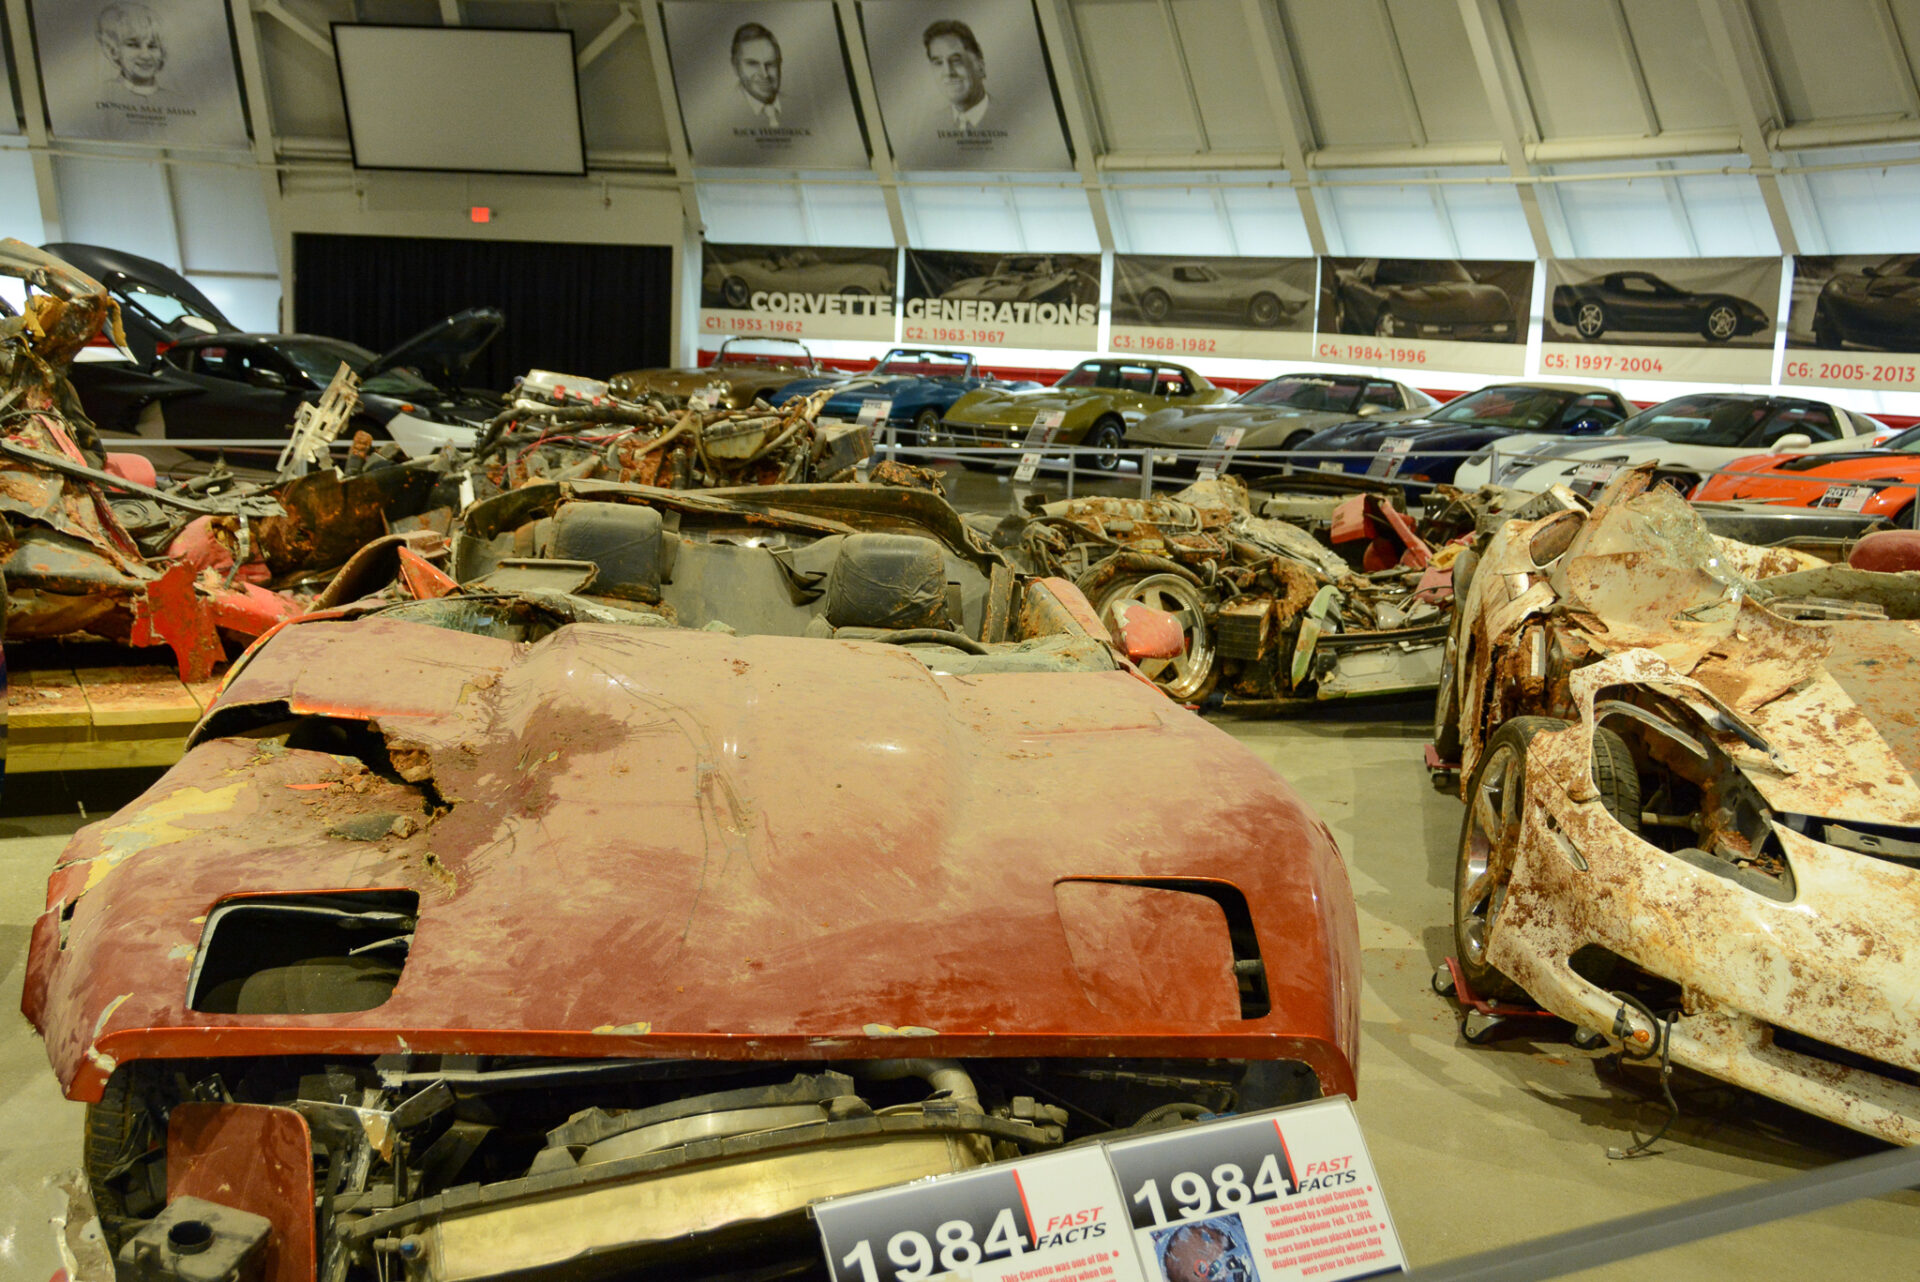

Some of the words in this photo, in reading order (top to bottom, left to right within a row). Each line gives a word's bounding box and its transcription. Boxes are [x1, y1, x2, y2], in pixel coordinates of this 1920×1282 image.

[749, 290, 892, 317] CORVETTE
[906, 297, 1096, 327] GENERATIONS
[706, 316, 726, 330] C1:
[730, 317, 804, 334] 1953-1962
[906, 326, 929, 341] C2:
[932, 328, 1006, 344] 1963-1967
[1113, 335, 1137, 349] C3:
[1139, 336, 1216, 353] 1968-1982
[1319, 343, 1343, 358] C4:
[1347, 345, 1426, 362] 1984-1996
[1544, 353, 1570, 369] C5:
[1575, 355, 1663, 373] 1997-2004
[1786, 362, 1814, 378] C6:
[1819, 363, 1916, 383] 2005-2013
[1306, 1155, 1353, 1178] FAST
[1133, 1154, 1291, 1226] 1984
[1298, 1169, 1356, 1193] FACTS
[1264, 1205, 1279, 1216] This
[1280, 1203, 1294, 1213] was
[1295, 1200, 1307, 1209] one
[1316, 1193, 1333, 1206] eight
[1333, 1186, 1365, 1201] Corvettes
[1270, 1212, 1307, 1228] swallowed
[1307, 1209, 1316, 1221] by
[1322, 1203, 1350, 1217] sinkhole
[1358, 1199, 1369, 1208] the
[1046, 1206, 1104, 1233] FAST
[1265, 1226, 1300, 1243] Museum's
[1300, 1219, 1330, 1234] Skydome
[842, 1208, 1029, 1282] 1984
[1035, 1222, 1106, 1251] FACTS
[1264, 1247, 1277, 1258] The
[1278, 1244, 1294, 1255] cars
[1294, 1240, 1311, 1251] have
[1311, 1235, 1328, 1247] been
[1329, 1230, 1351, 1244] placed
[1352, 1225, 1368, 1237] back
[1369, 1224, 1378, 1233] on
[1272, 1255, 1298, 1271] display
[1298, 1244, 1346, 1265] approximately
[1346, 1239, 1367, 1252] where
[1367, 1236, 1382, 1248] they
[1301, 1265, 1319, 1276] were
[1319, 1259, 1337, 1273] prior
[1336, 1257, 1344, 1266] to
[1344, 1255, 1356, 1265] the
[1019, 1265, 1054, 1281] Corvette
[1054, 1262, 1071, 1273] was
[1071, 1258, 1087, 1268] one
[1087, 1254, 1096, 1265] of
[1096, 1252, 1109, 1263] the
[1077, 1268, 1100, 1281] when
[1099, 1265, 1113, 1276] the
